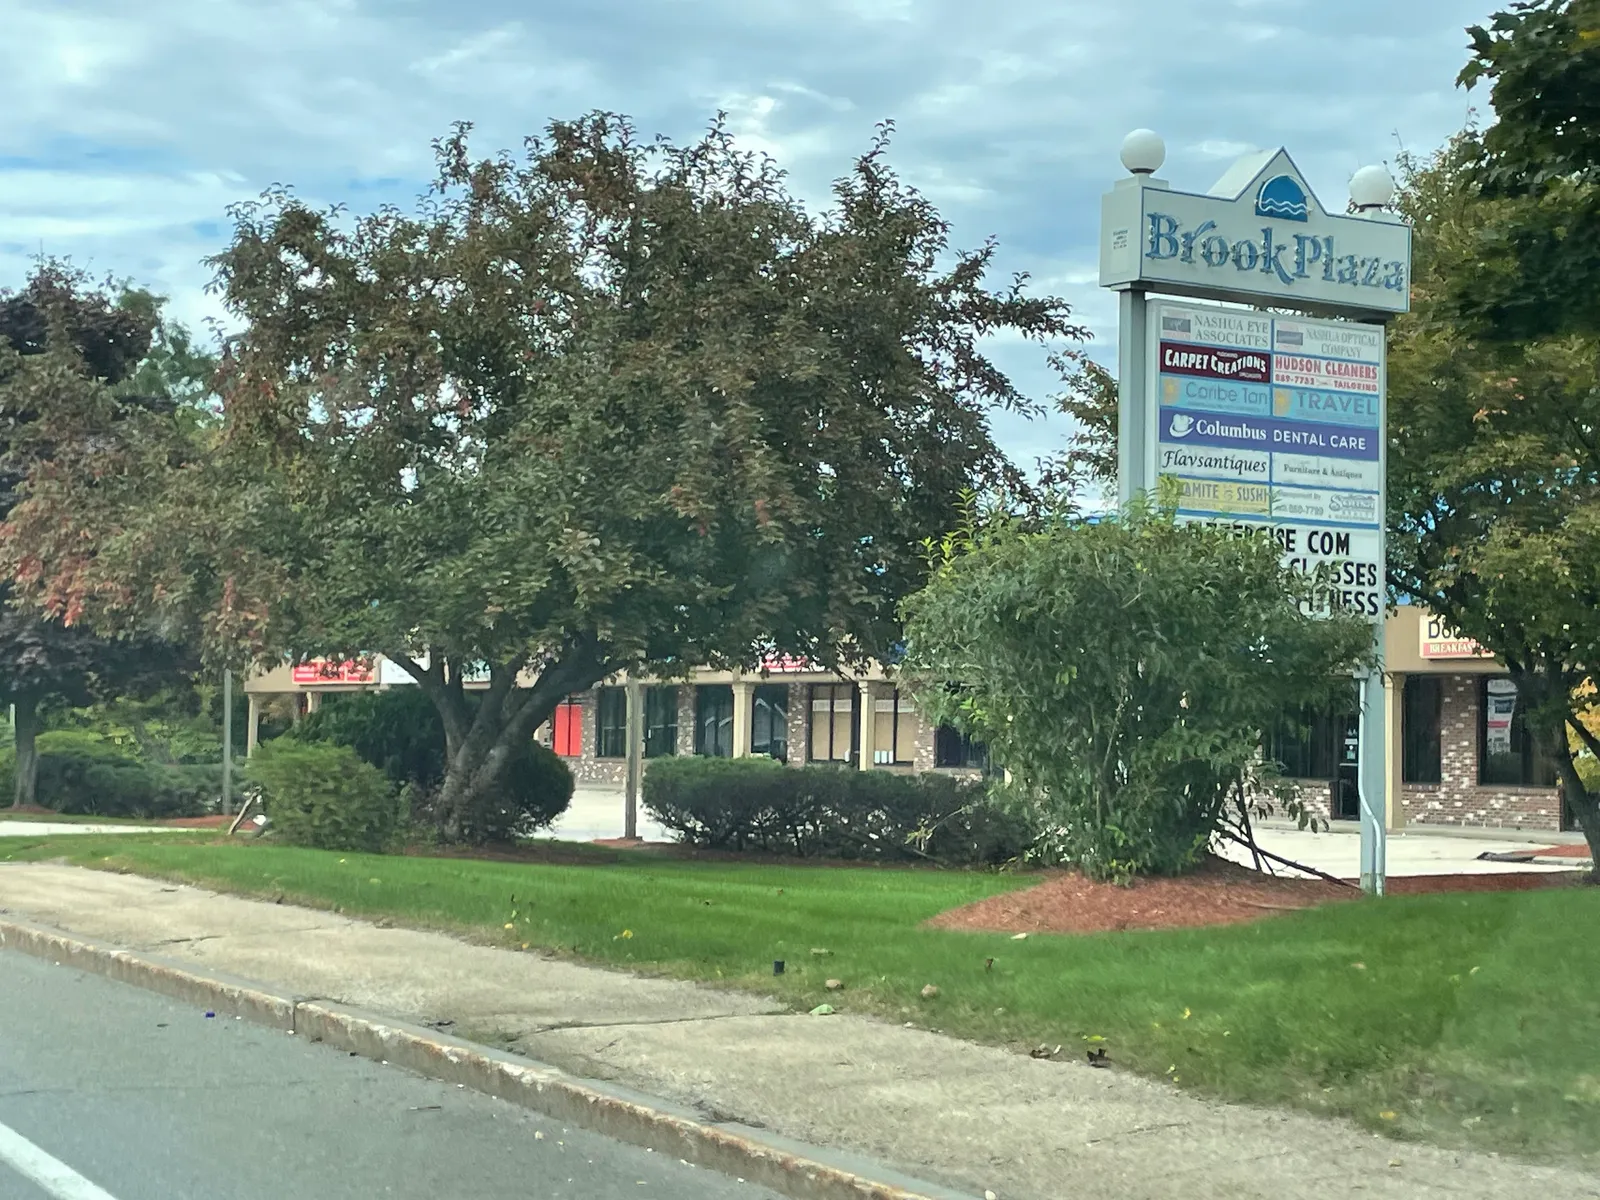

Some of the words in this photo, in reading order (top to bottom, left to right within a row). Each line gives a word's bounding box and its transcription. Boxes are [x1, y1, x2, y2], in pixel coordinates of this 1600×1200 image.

[1145, 212, 1295, 285] Brook
[1292, 233, 1406, 292] Plaza
[1194, 315, 1243, 332] NASHUA
[1247, 320, 1269, 334] EYE
[1195, 331, 1269, 347] ASSOCIATES
[1341, 331, 1377, 347] OPTICAL
[1321, 343, 1362, 358] COMPANY
[1164, 348, 1209, 370] CARPET
[1210, 354, 1267, 375] CREATIONS
[1275, 356, 1321, 373] HUDSON
[1325, 361, 1378, 380] CLEANERS
[1185, 381, 1238, 402] Caribe
[1242, 387, 1268, 405] Tan
[1333, 380, 1378, 392] TAILORING
[1297, 391, 1377, 415] TRAVEL
[1196, 419, 1267, 440] Columbus
[1274, 429, 1325, 446] DENTAL
[1330, 435, 1367, 450] CARE
[1284, 464, 1321, 476] Furniture
[1322, 467, 1328, 476] &
[1331, 466, 1363, 480] Antiques
[1237, 486, 1267, 503] SUSHI
[1308, 530, 1350, 556] COM
